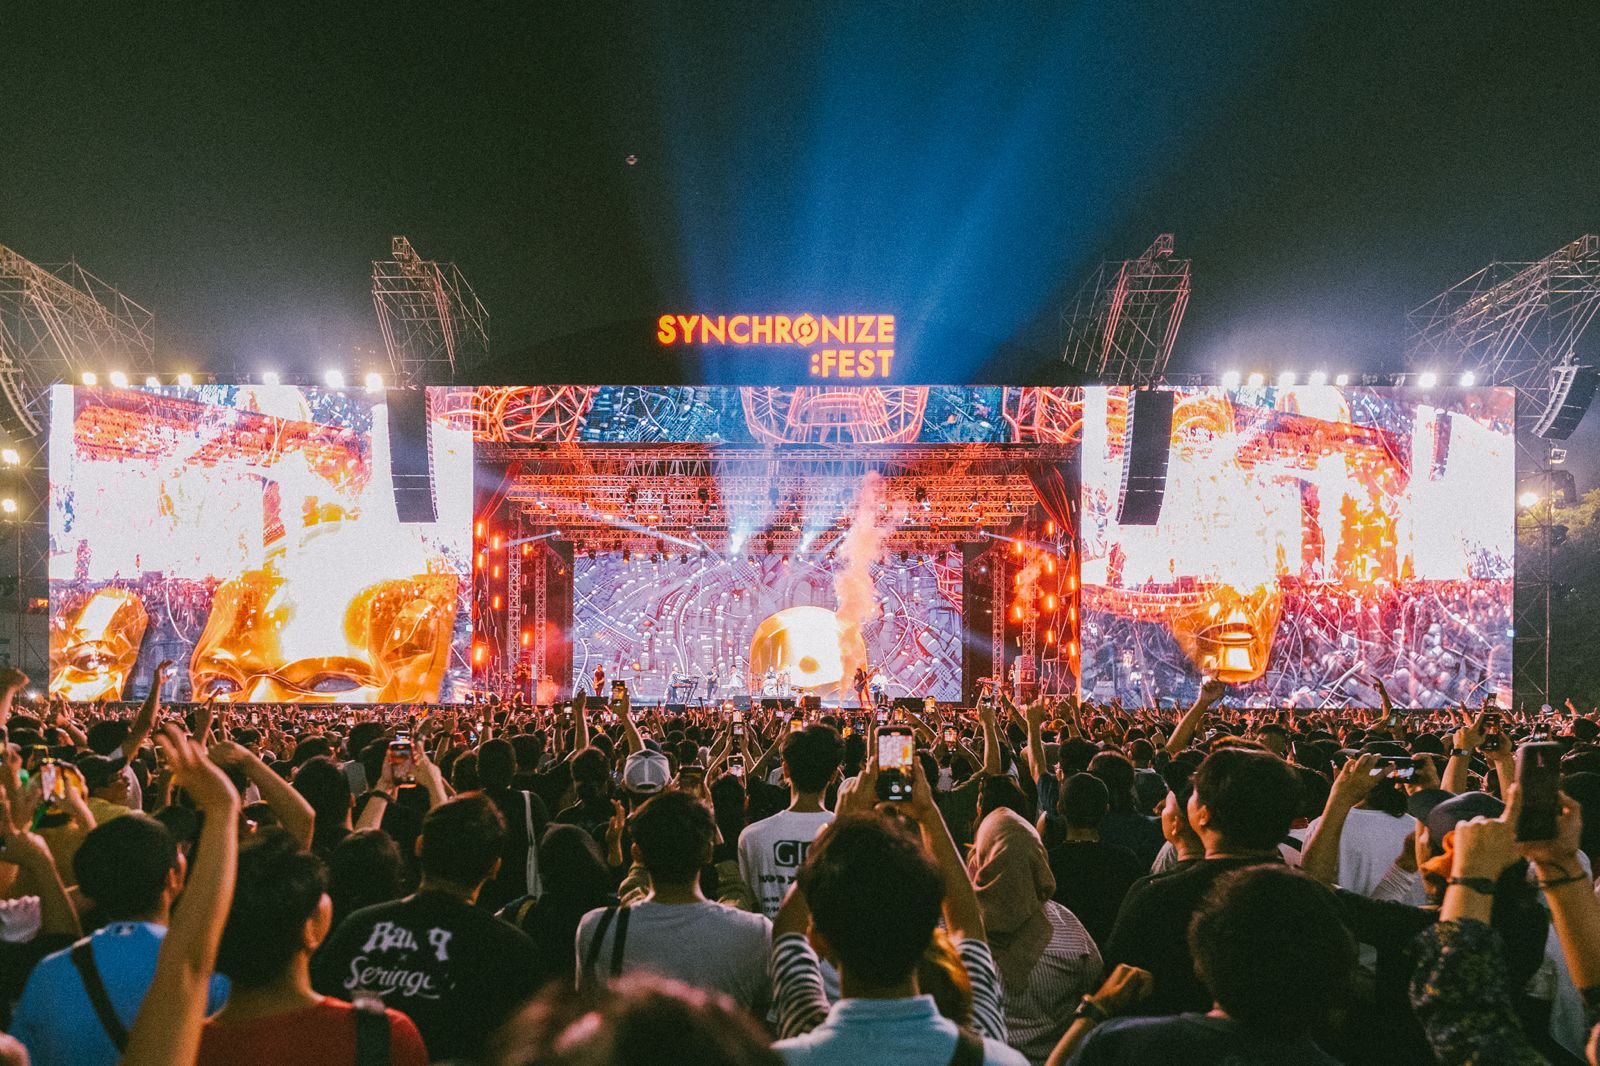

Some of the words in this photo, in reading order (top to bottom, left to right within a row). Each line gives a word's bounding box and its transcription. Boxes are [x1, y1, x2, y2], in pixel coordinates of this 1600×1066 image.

[657, 313, 895, 346] SYNCHRONIZE
[811, 349, 895, 378] :FEST
[775, 841, 812, 866] GI
